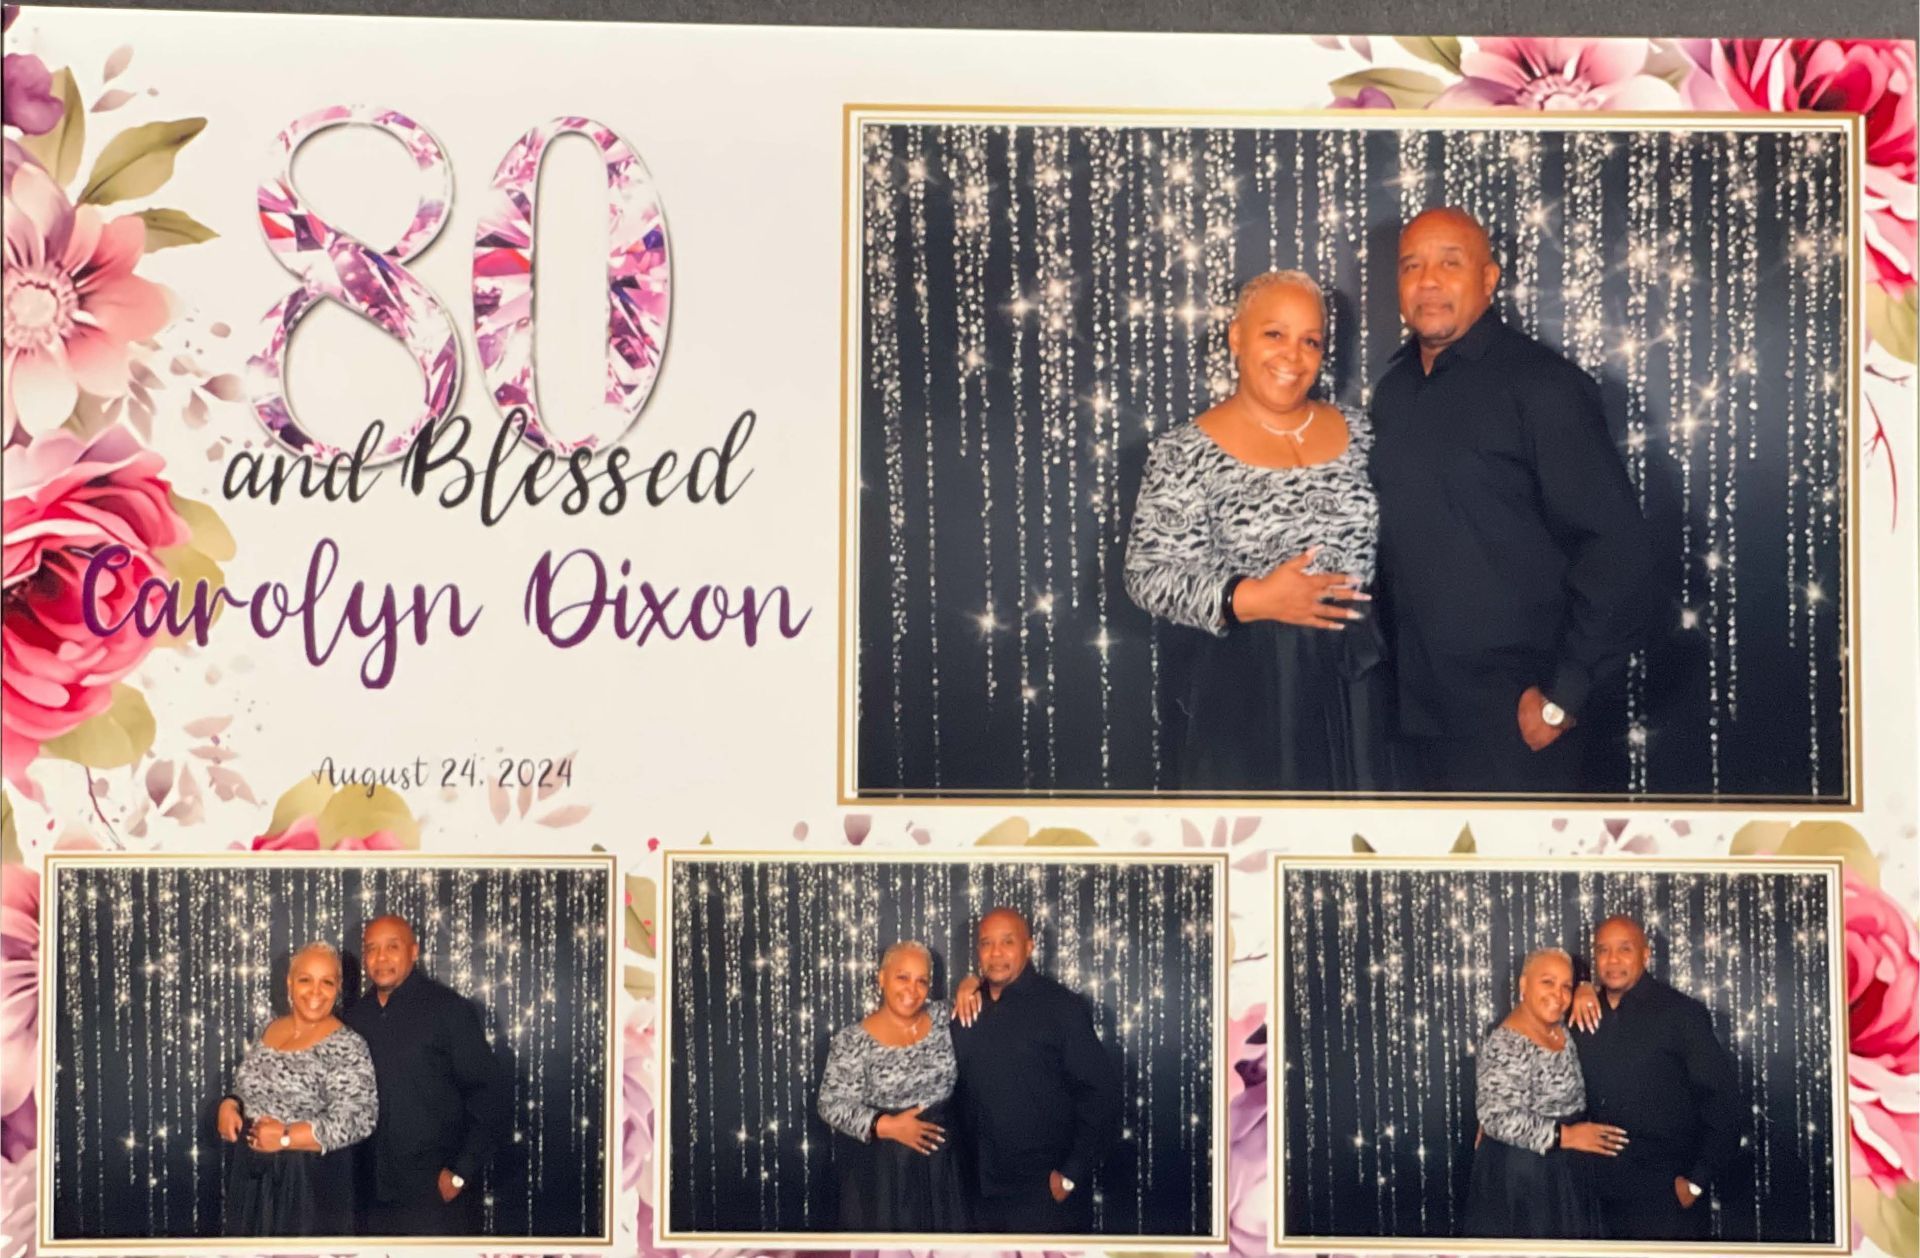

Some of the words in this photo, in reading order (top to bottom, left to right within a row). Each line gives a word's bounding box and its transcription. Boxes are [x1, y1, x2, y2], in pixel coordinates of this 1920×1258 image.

[246, 103, 673, 468] 80
[222, 418, 384, 505] and
[401, 408, 757, 527] Blessed
[79, 538, 484, 690] Carolyn
[524, 548, 812, 649] Dixon
[311, 756, 428, 798] August
[498, 758, 573, 788] 2024
